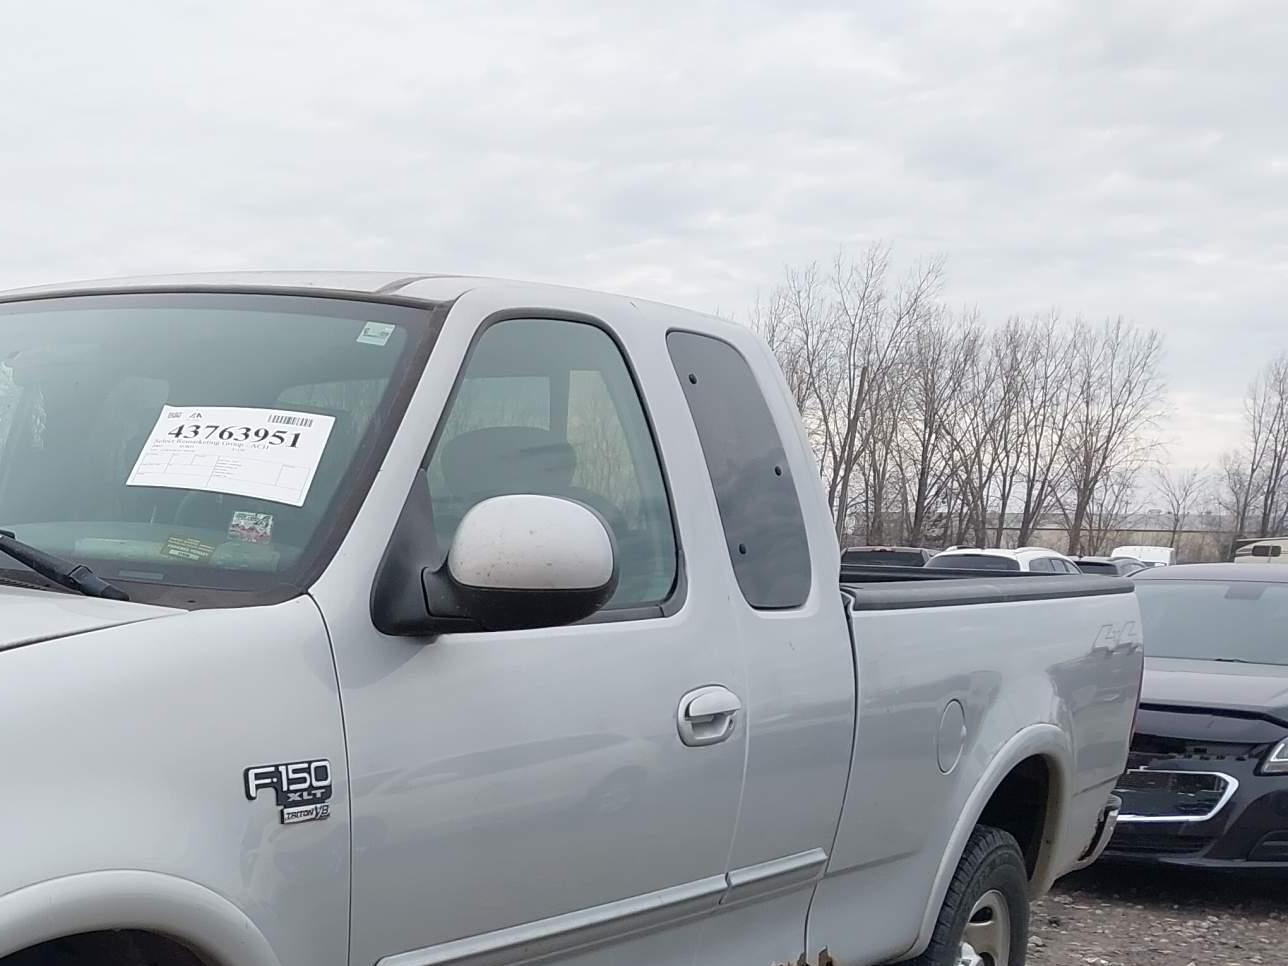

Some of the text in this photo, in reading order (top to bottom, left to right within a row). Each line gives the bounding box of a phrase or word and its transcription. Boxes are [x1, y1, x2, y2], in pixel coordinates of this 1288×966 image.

[167, 424, 301, 448] 43763951
[286, 788, 326, 802] XLT
[285, 804, 330, 820] TRITON V8
